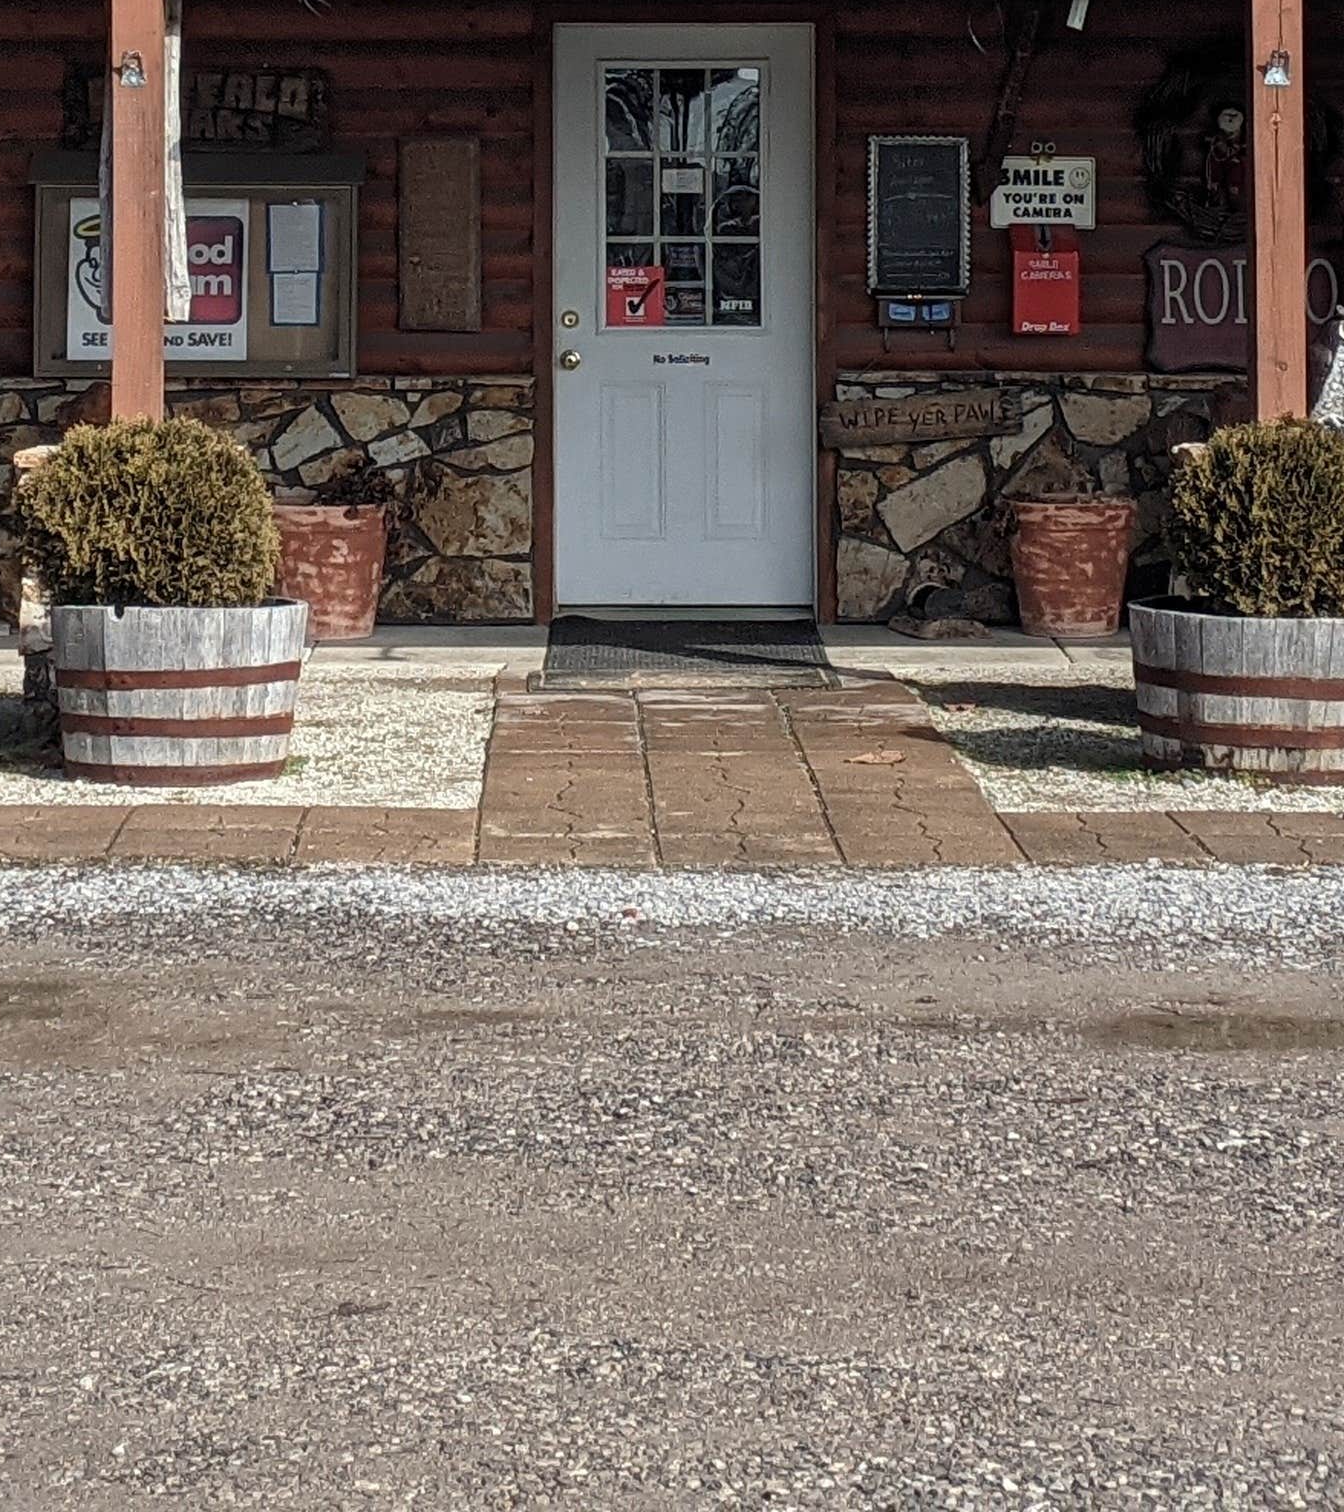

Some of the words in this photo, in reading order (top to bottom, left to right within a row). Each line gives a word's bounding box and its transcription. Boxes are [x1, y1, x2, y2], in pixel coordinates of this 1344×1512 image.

[1000, 168, 1064, 186] SMILE
[1003, 192, 1056, 205] YOU'RE
[1062, 193, 1084, 205] ON
[1013, 206, 1073, 219] CAMERA
[188, 235, 233, 265] od
[1159, 258, 1338, 326] ROO
[82, 332, 108, 347] SEE
[164, 335, 184, 346] ND
[187, 332, 232, 347] SAVE!
[653, 354, 666, 363] No
[838, 407, 899, 430] WIPE
